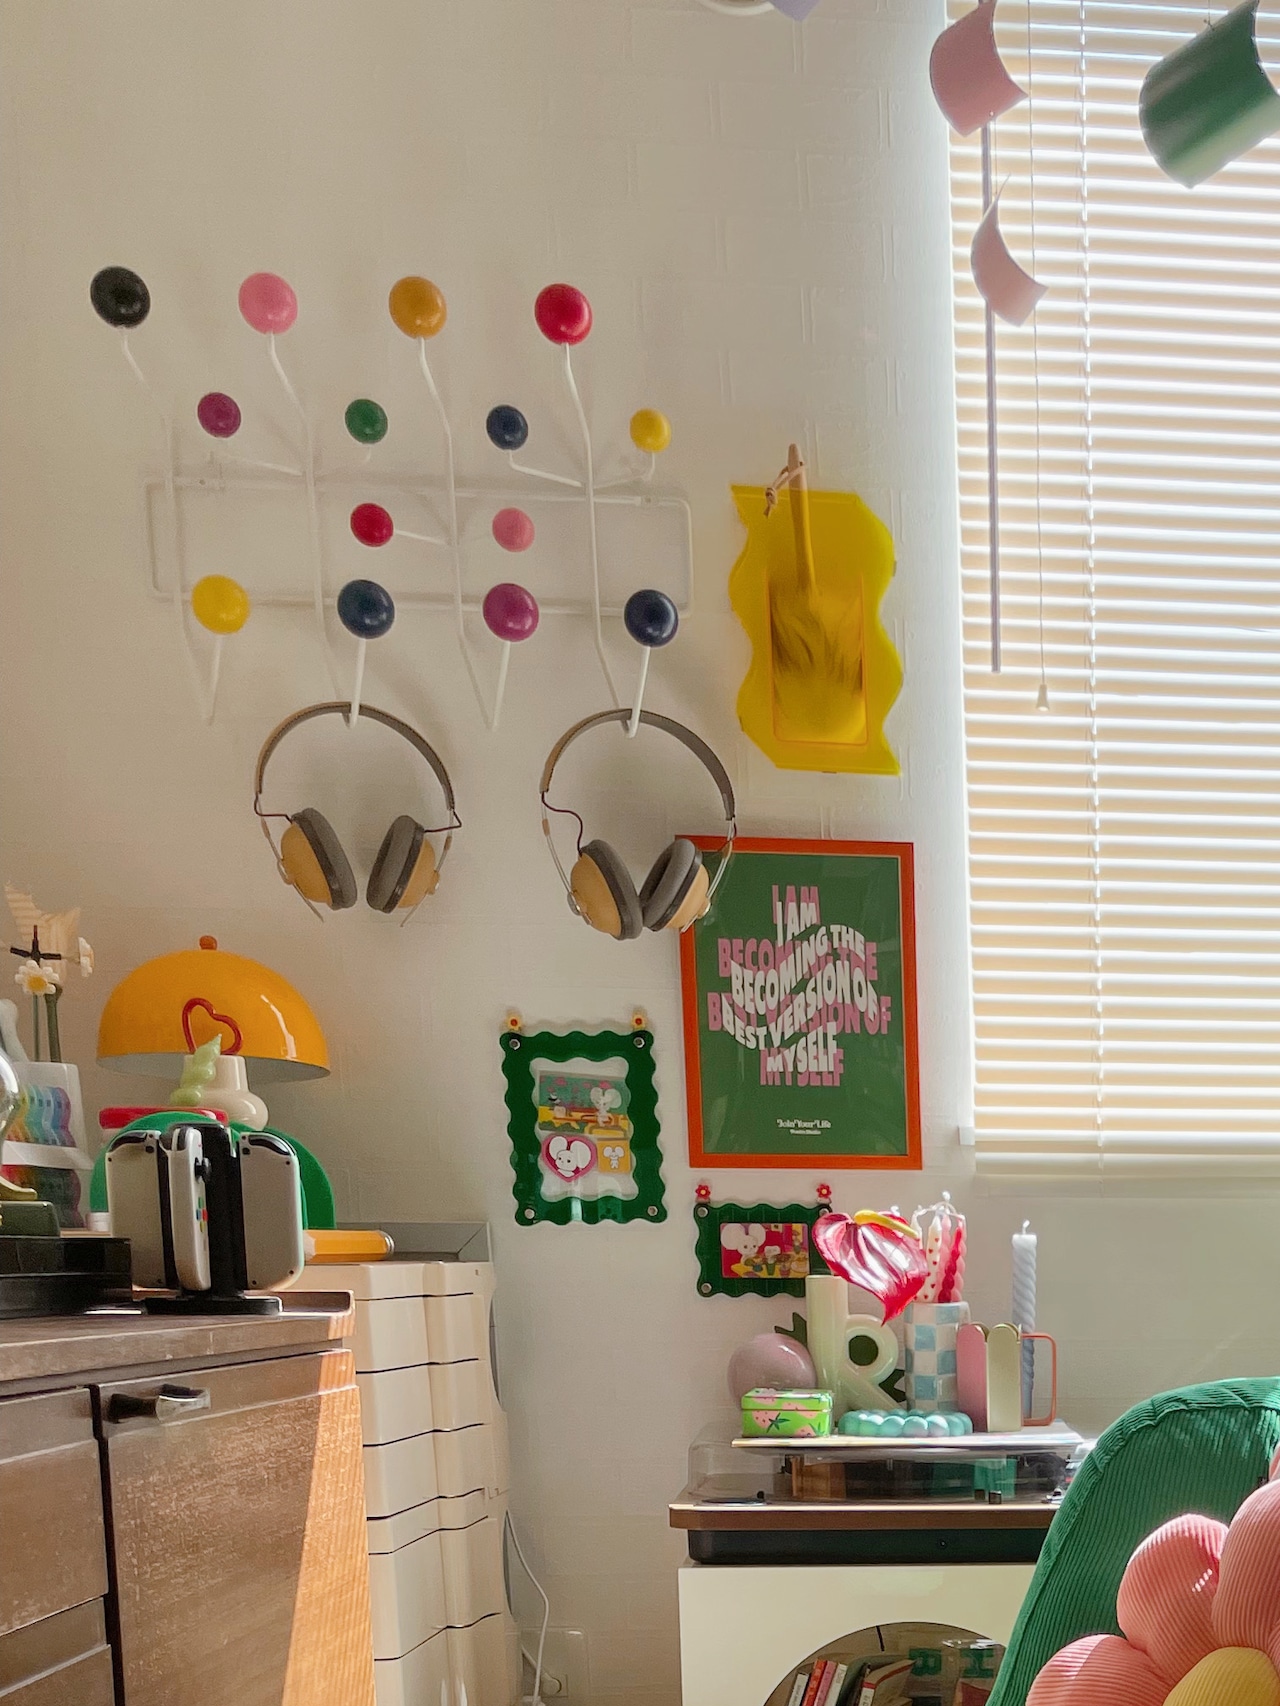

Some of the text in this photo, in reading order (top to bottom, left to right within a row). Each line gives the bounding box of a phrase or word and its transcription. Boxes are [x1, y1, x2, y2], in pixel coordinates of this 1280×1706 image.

[777, 901, 817, 947] I AM
[731, 925, 865, 1015] BECOMING THE
[721, 960, 878, 1051] BEST VERSION OF
[767, 1022, 837, 1073] MYSELF
